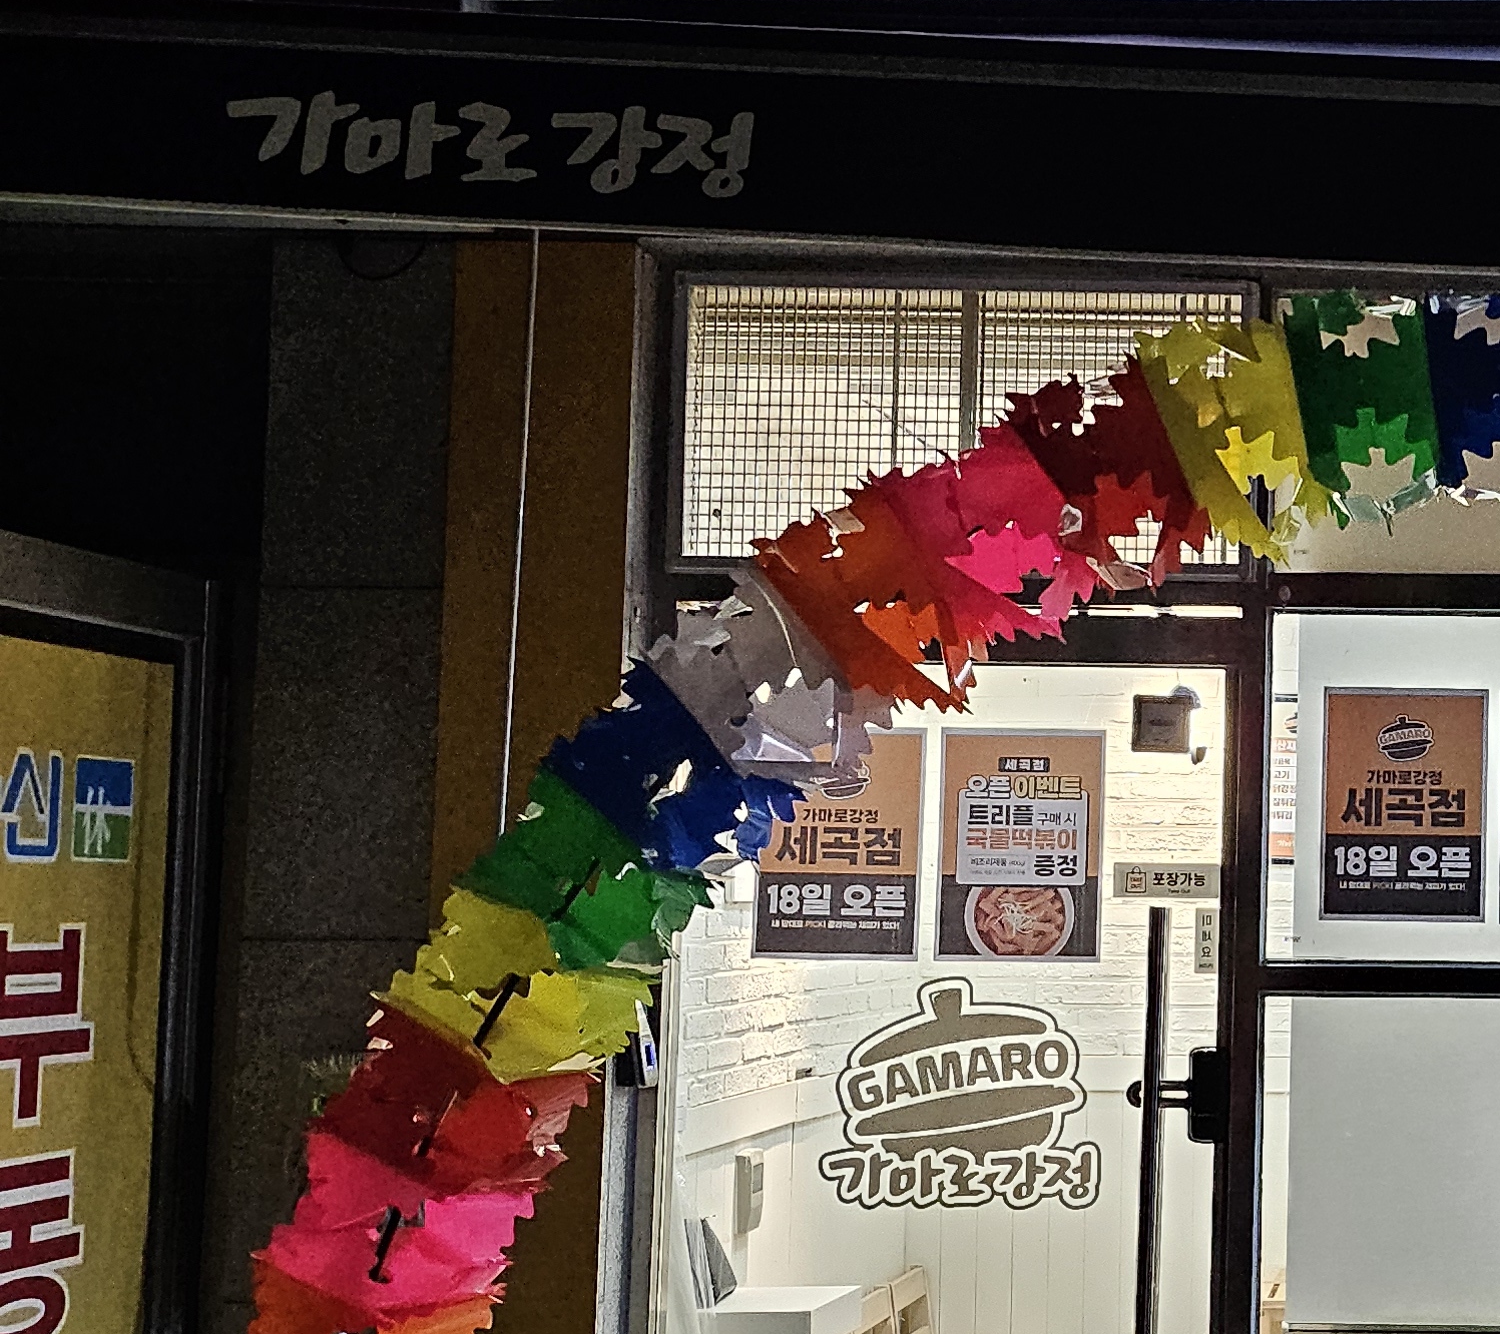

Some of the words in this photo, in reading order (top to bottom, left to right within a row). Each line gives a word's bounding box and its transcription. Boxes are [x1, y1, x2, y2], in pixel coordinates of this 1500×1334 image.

[1379, 727, 1431, 745] GAMARO
[965, 775, 1011, 799] 오픈
[1013, 775, 1082, 799] 이벤트
[1366, 769, 1443, 786] 가마로강정
[803, 808, 879, 824] 가마로강정
[967, 803, 1034, 827] 트리플
[1340, 787, 1466, 828] 세곡점
[775, 825, 902, 867] 세곡점
[965, 827, 1078, 850] 국물떡볶이
[1033, 854, 1078, 877] 증정
[1334, 845, 1398, 878] 18일
[1407, 845, 1472, 878] 오픈
[1152, 872, 1206, 887] 포장가능
[767, 883, 832, 916] 18일
[840, 884, 907, 917] 오픈
[848, 1039, 1069, 1111] GAMARO
